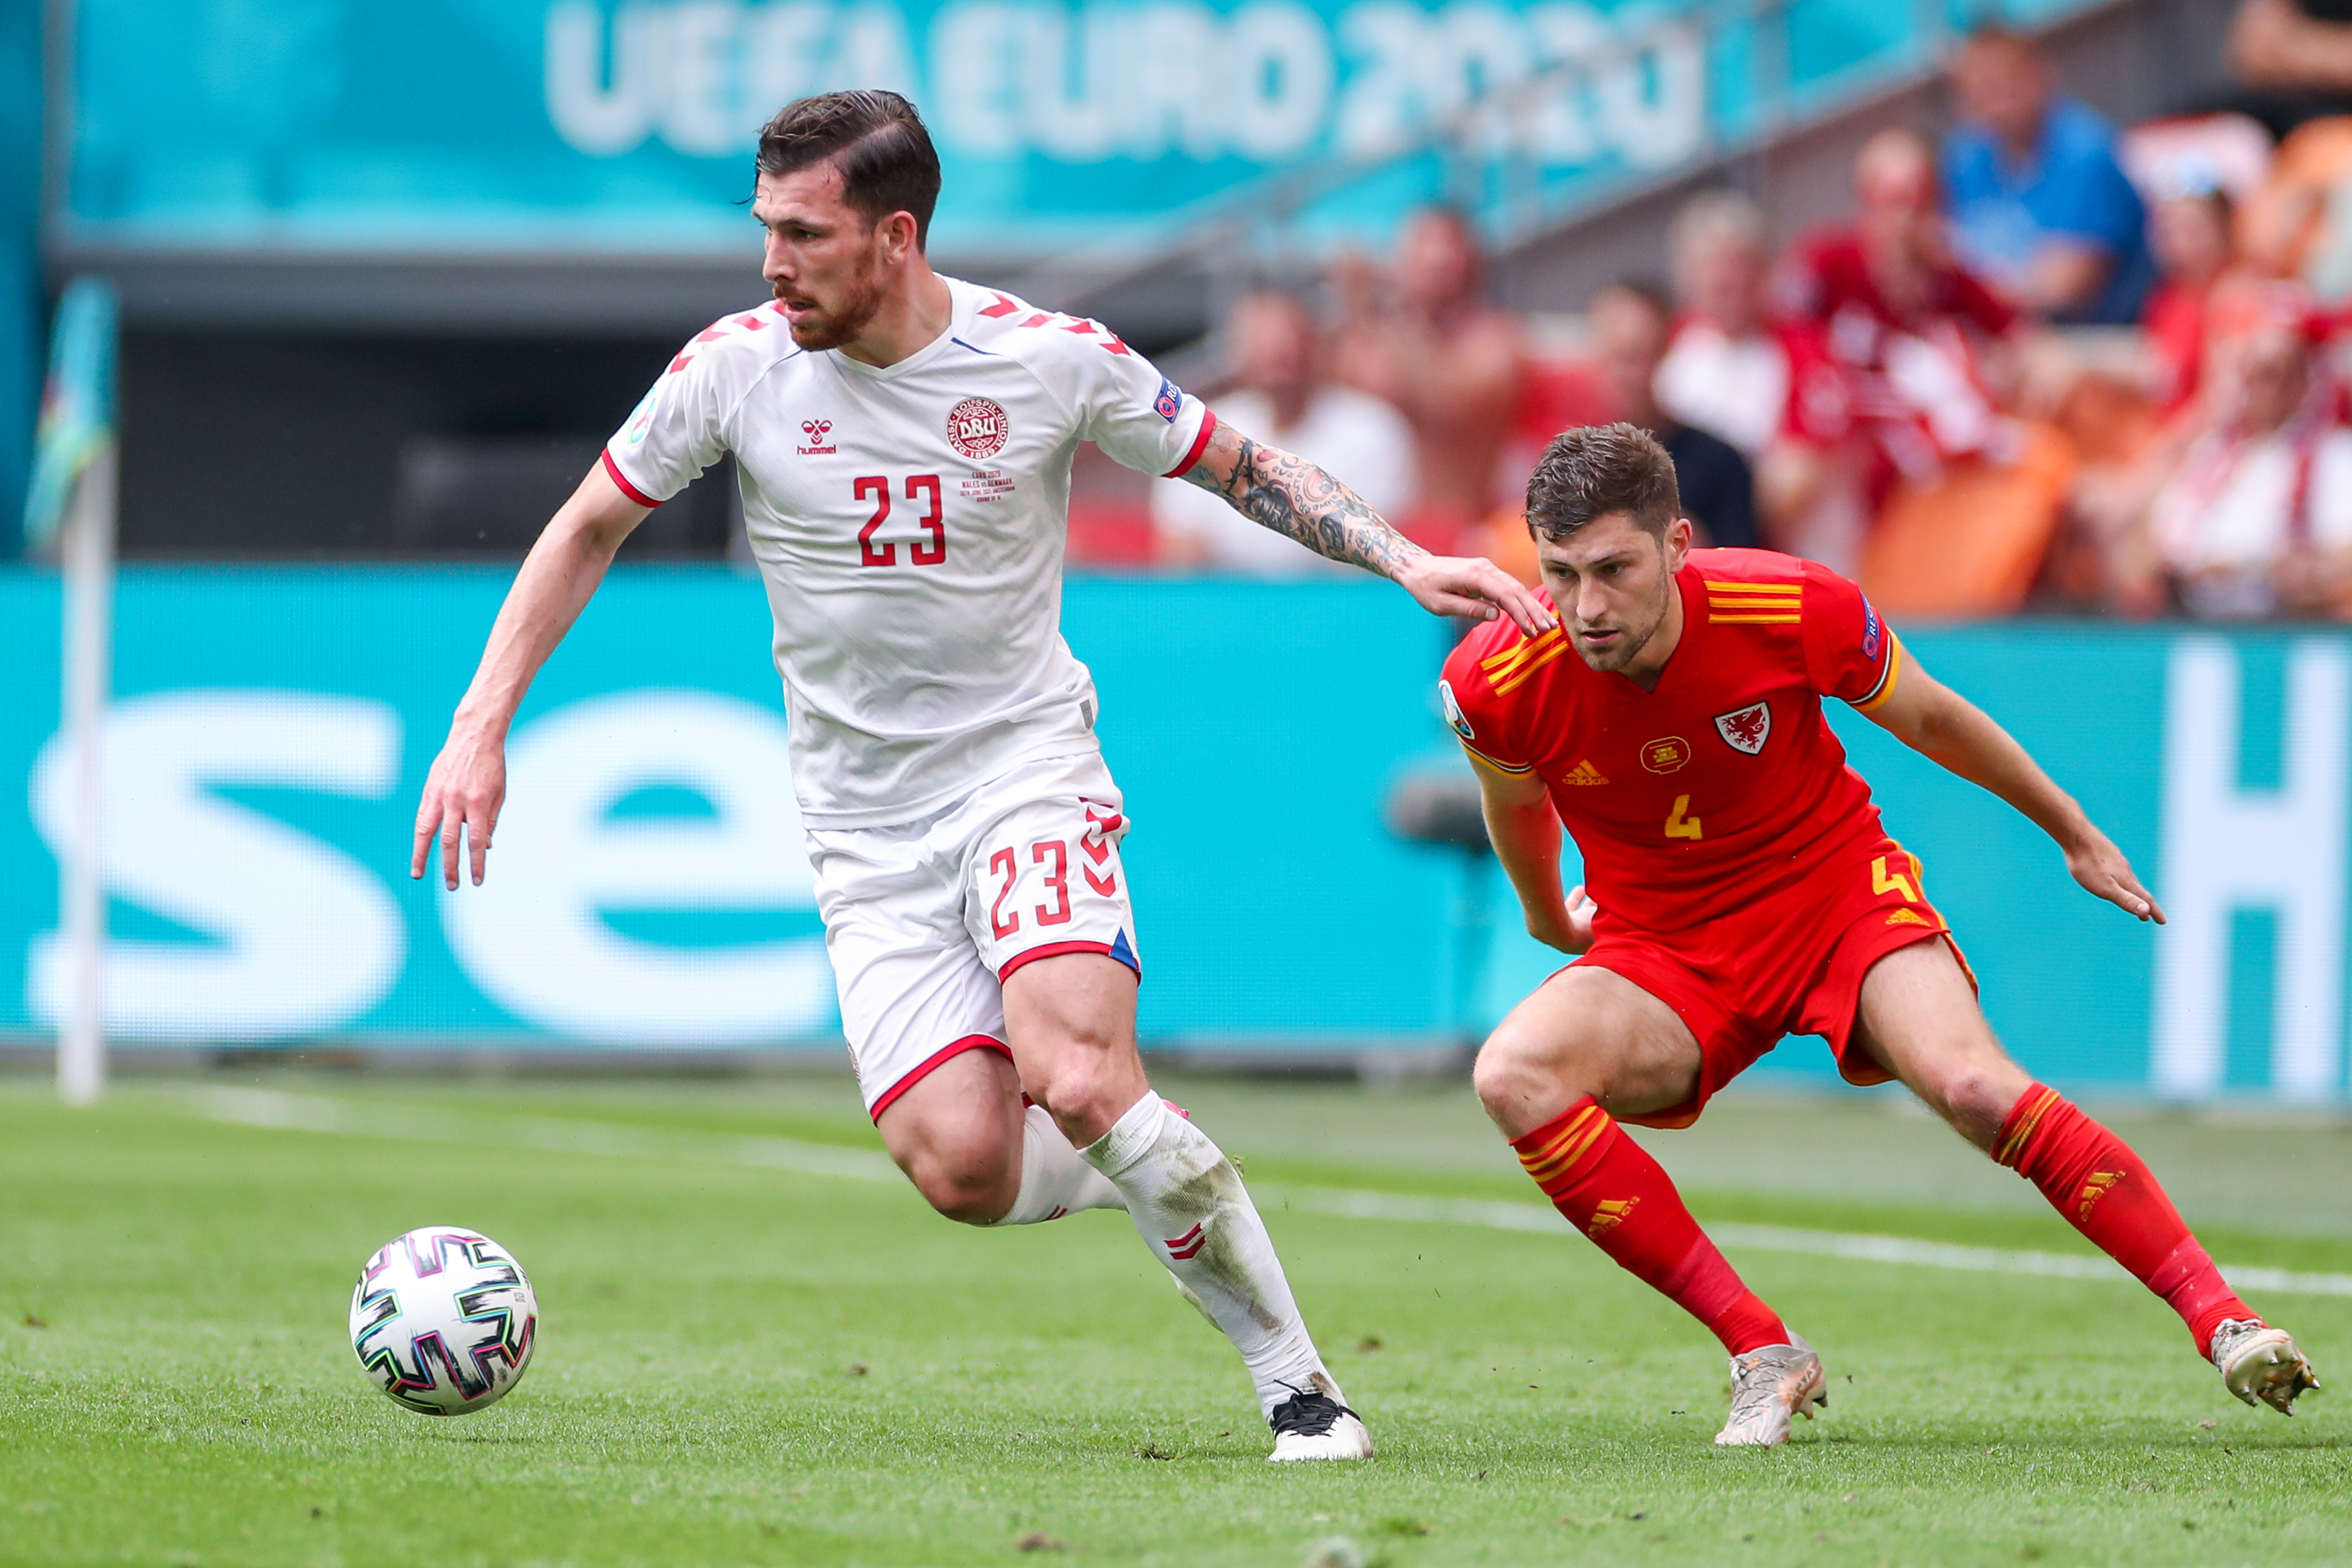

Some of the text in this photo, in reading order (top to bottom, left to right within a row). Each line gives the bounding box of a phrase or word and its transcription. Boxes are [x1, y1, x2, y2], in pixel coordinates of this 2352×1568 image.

[545, 0, 1705, 168] UEFA EURO 2020
[797, 444, 836, 455] hummel
[948, 419, 967, 454] DANSK
[959, 417, 997, 439] DBU
[970, 448, 996, 459] 1889
[854, 474, 946, 567] 23
[1562, 777, 1609, 786] adidas
[1664, 794, 1702, 841] 4
[26, 687, 841, 1039] se
[1871, 856, 1919, 903] 4
[990, 840, 1071, 942] 23
